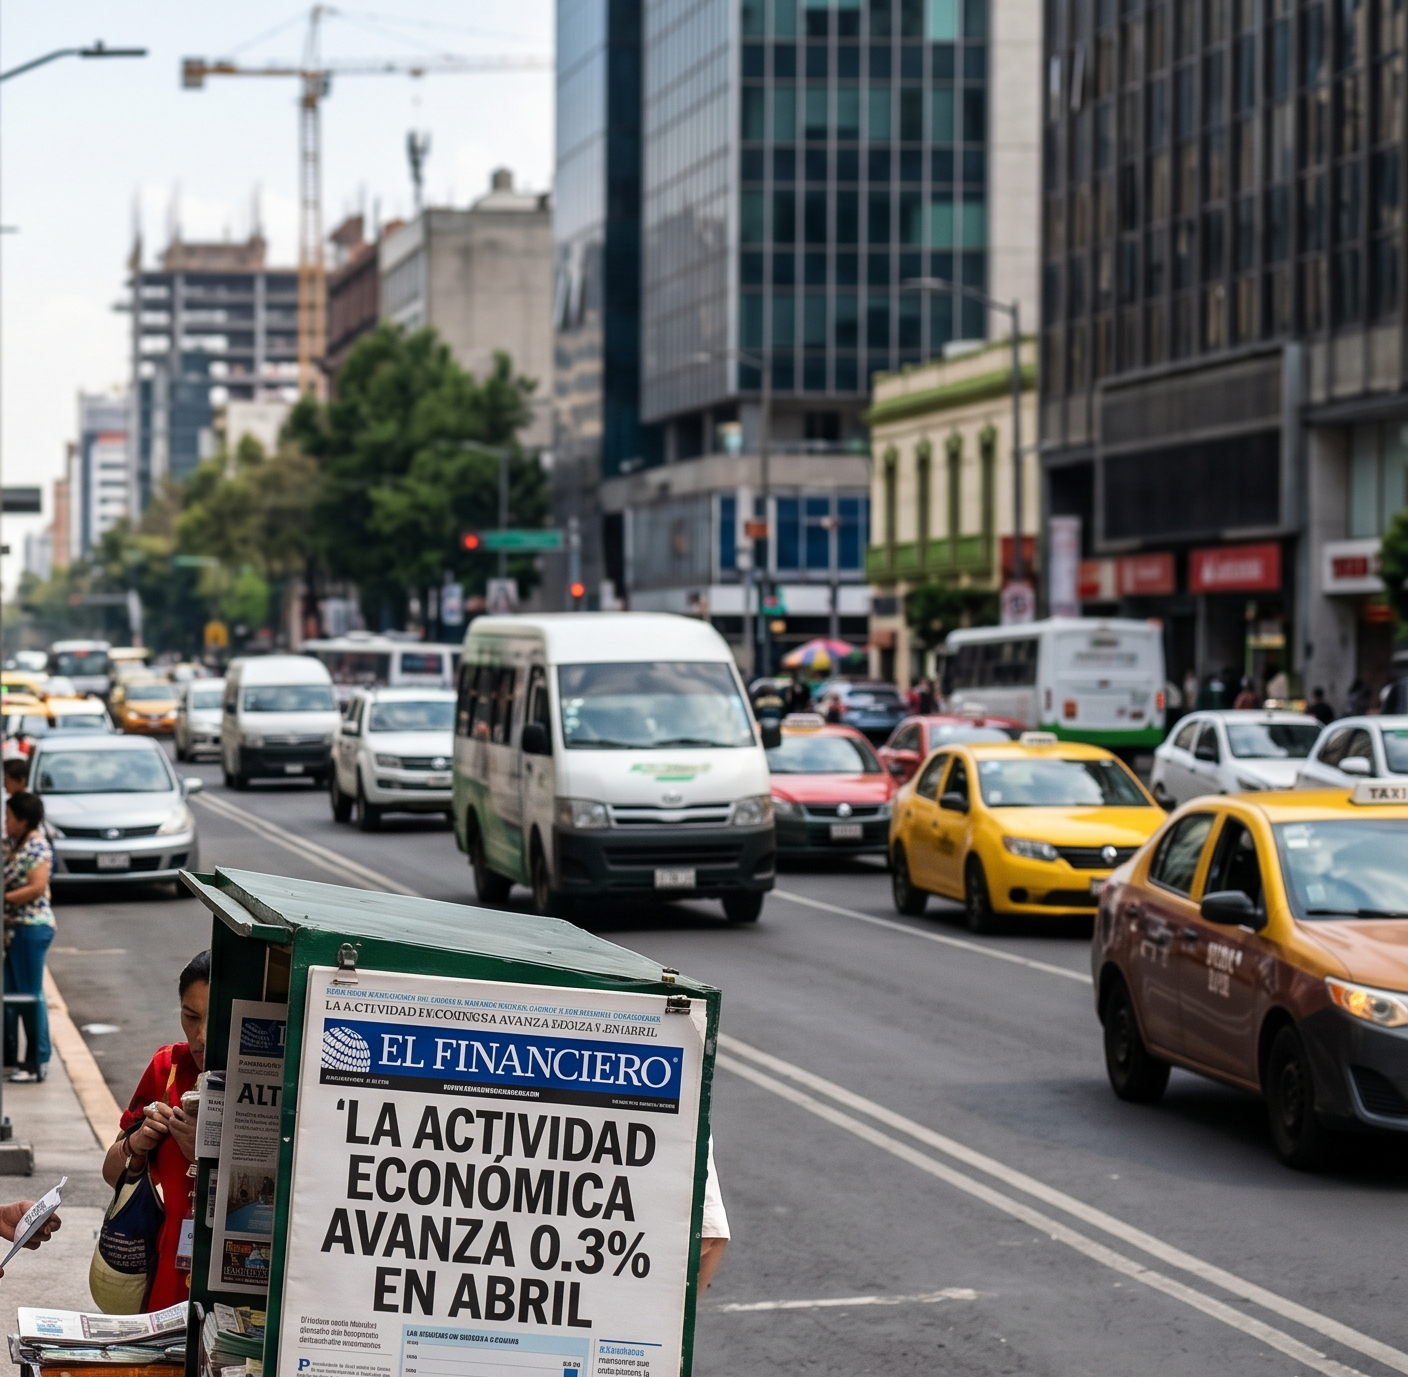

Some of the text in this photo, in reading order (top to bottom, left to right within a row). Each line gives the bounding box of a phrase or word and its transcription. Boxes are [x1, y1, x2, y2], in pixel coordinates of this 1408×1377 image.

[1369, 787, 1407, 799] TAXI
[378, 1034, 425, 1067] EL
[432, 1039, 672, 1088] FINANCIERO
[412, 1106, 656, 1167] ACTIVIDAD
[347, 1154, 636, 1221] ECONÓMICA
[321, 1208, 651, 1279] AVANZA 0.3%
[373, 1267, 593, 1328] EN ABRIL
